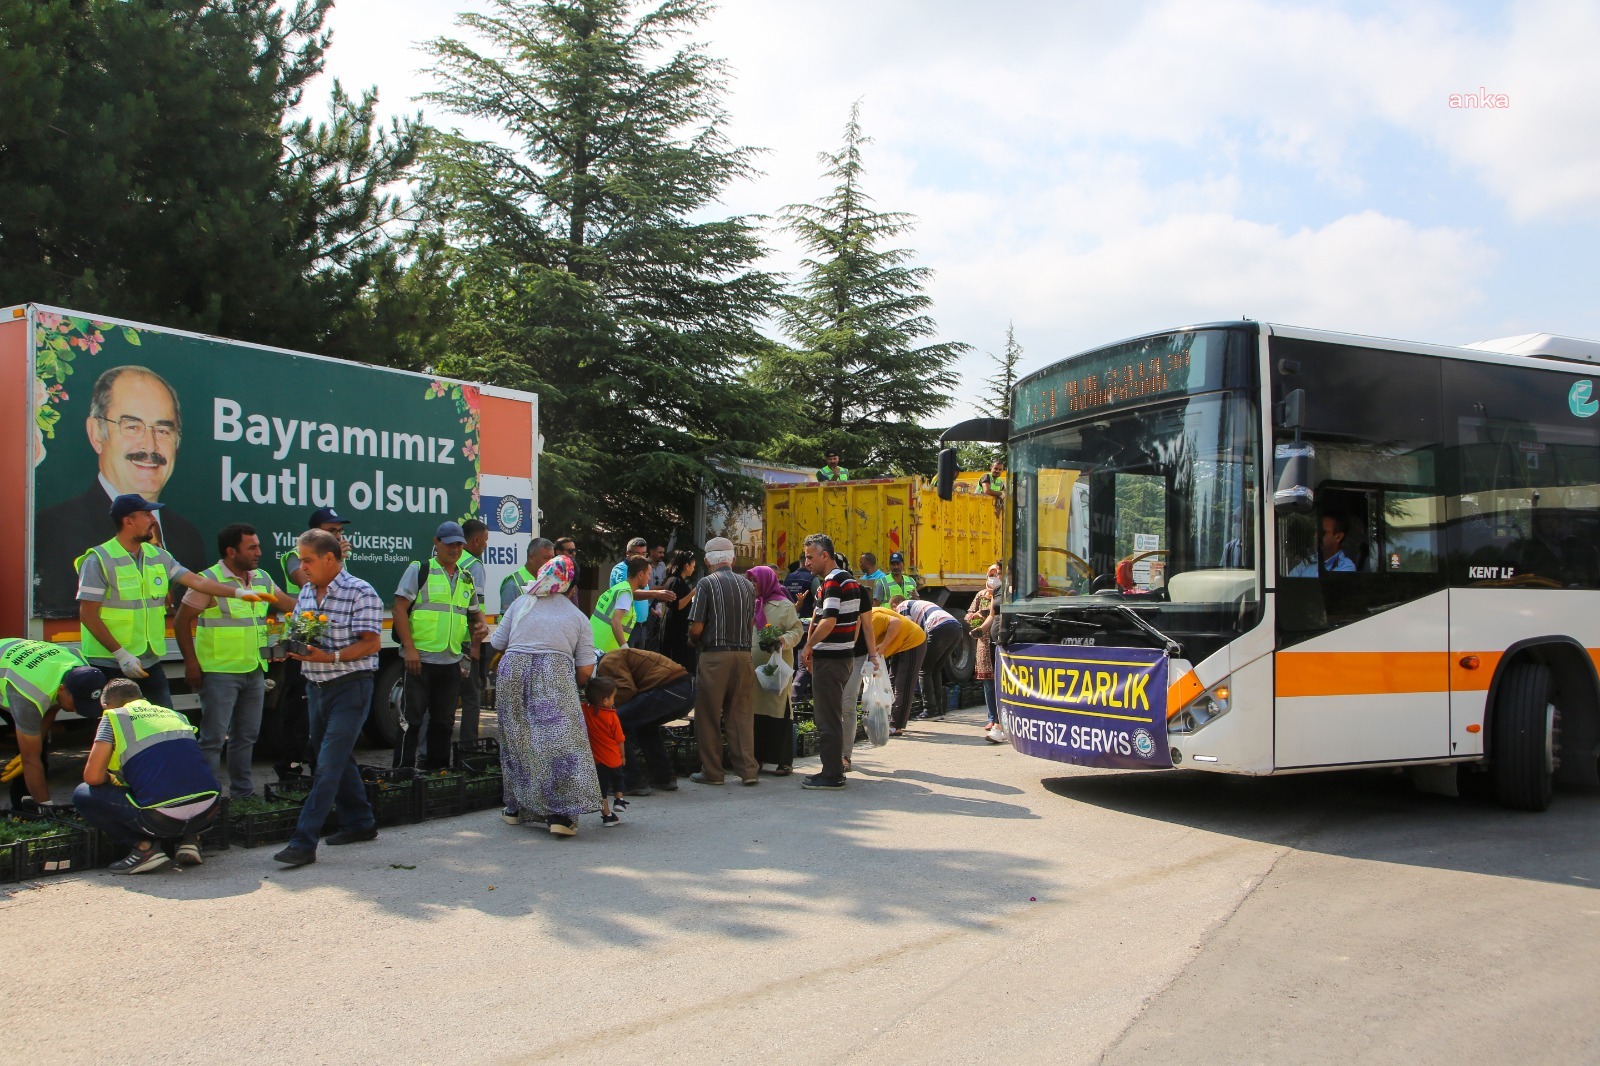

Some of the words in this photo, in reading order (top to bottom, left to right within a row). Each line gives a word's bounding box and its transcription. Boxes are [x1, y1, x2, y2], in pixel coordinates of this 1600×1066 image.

[213, 397, 455, 464] Bayramımız
[221, 455, 335, 508] kutlu
[348, 469, 449, 514] olsun
[341, 531, 413, 553] YÜKERŞEN
[352, 553, 383, 563] Belediye
[384, 553, 410, 563] Başkanı
[1468, 566, 1499, 579] KENT
[1500, 567, 1515, 579] LF
[1036, 667, 1150, 711] MEZARLIK
